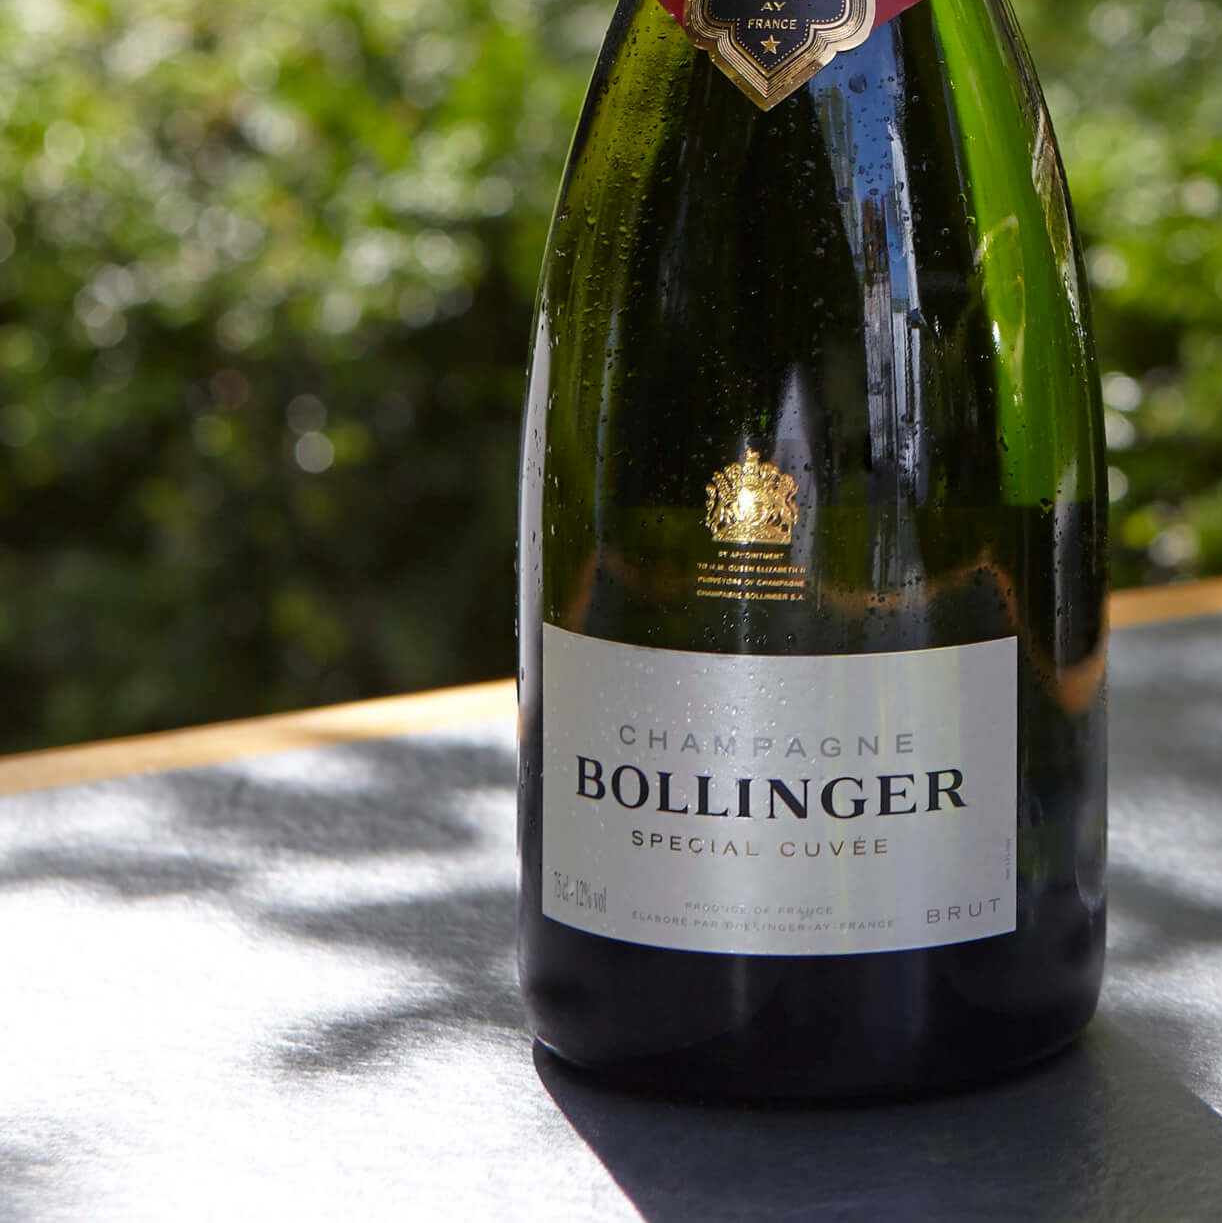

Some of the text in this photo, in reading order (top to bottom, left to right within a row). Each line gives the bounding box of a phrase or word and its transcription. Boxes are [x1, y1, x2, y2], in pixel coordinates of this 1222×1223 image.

[760, 1, 787, 11] AY
[747, 18, 797, 30] FRANCE
[619, 724, 914, 758] CHAMPAGNE
[575, 755, 968, 820] BOLLINGER
[631, 829, 889, 858] SPECIAL CUVÉE
[926, 897, 1002, 925] BRUT
